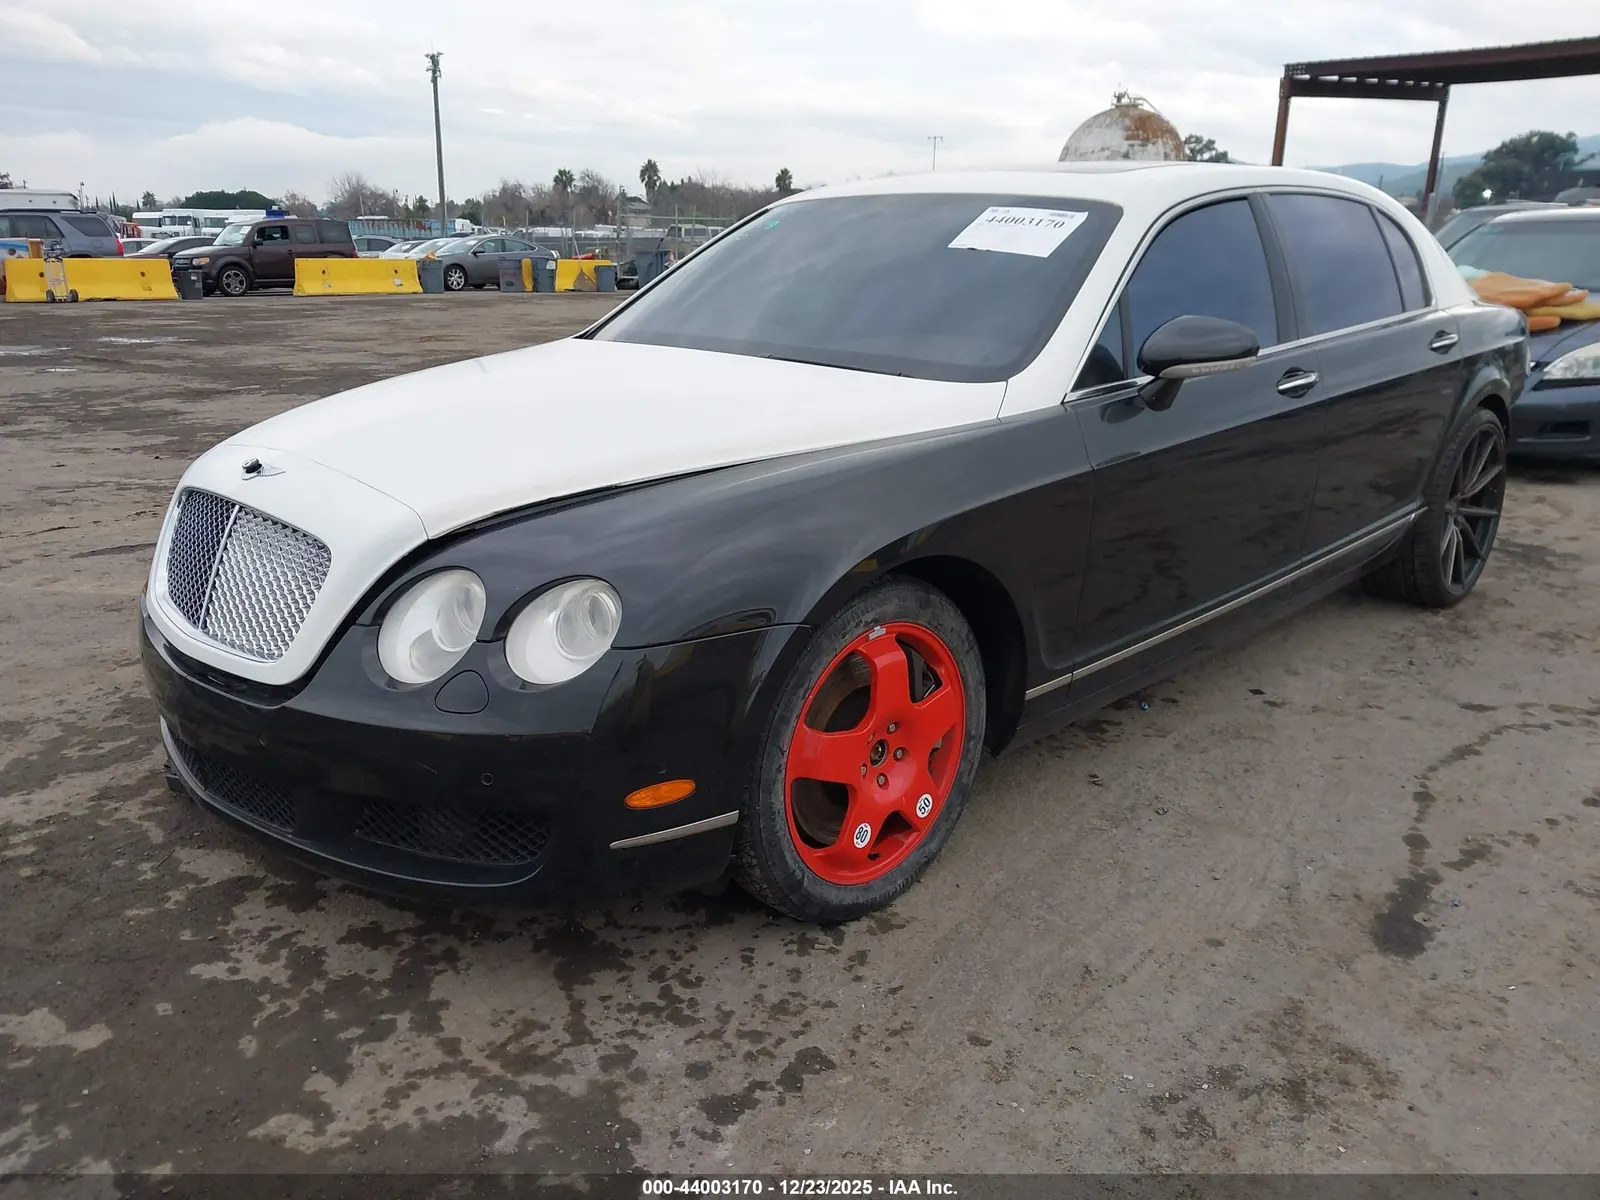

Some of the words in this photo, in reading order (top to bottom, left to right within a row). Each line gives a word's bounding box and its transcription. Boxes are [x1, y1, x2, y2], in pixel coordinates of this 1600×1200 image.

[985, 215, 1066, 229] 44003170
[918, 797, 930, 814] 50
[856, 826, 868, 843] 80
